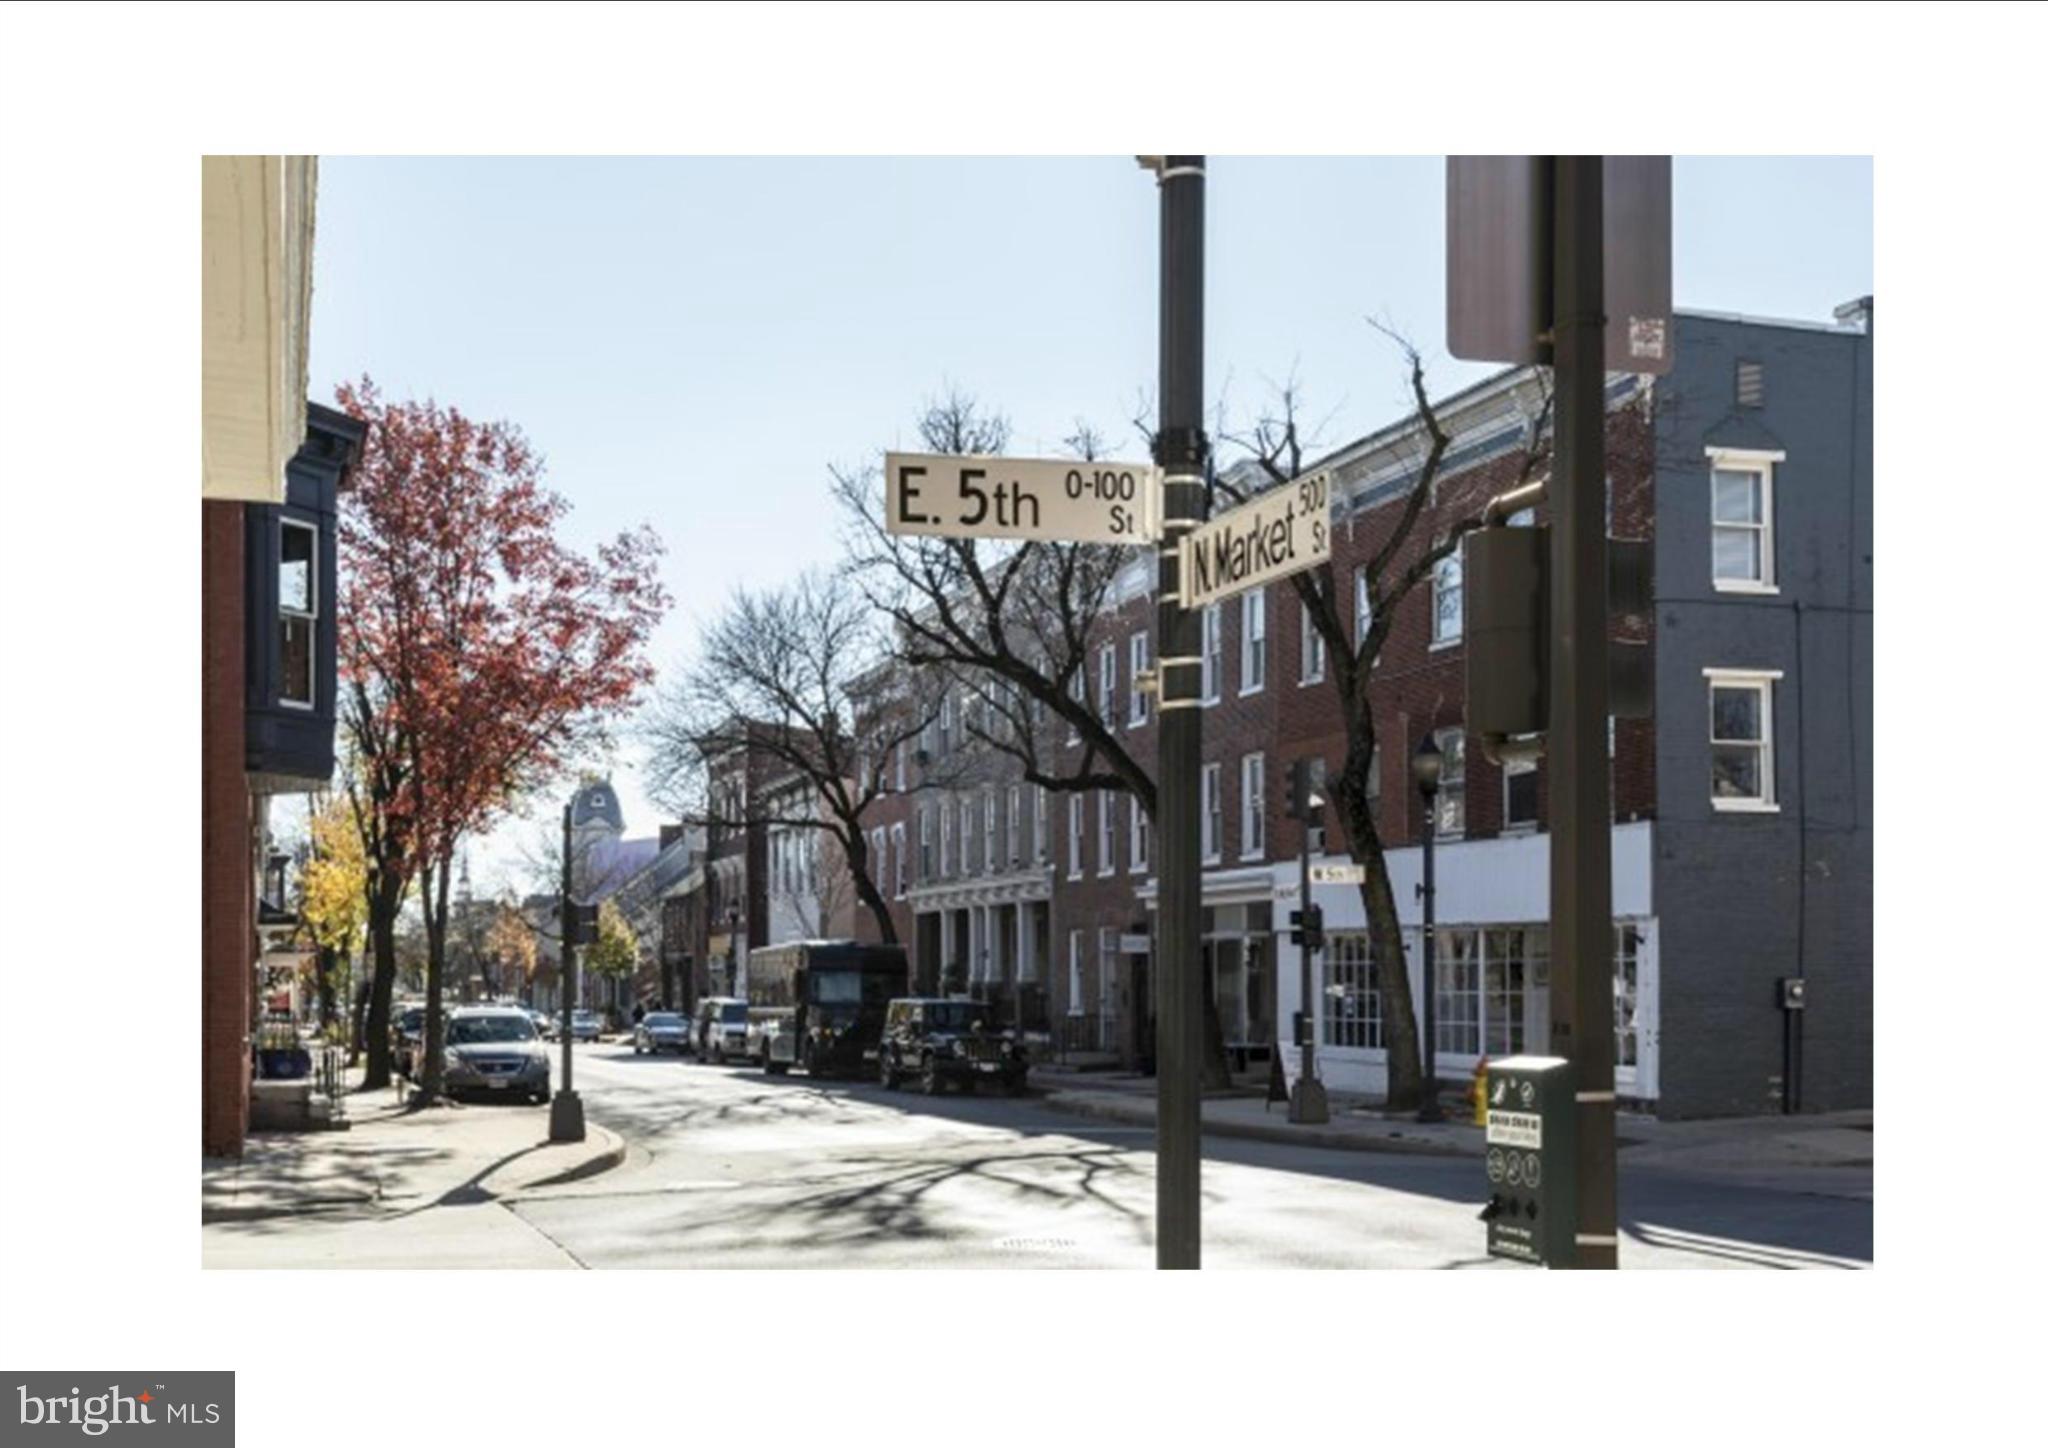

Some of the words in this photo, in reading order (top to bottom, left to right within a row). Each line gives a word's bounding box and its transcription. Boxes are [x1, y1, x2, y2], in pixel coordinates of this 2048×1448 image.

[898, 466, 942, 524] E.
[958, 469, 1040, 526] 5th
[1065, 470, 1136, 502] 0-100
[1298, 475, 1326, 517] 500
[1108, 504, 1135, 534] St
[1312, 520, 1326, 554] St
[1194, 536, 1212, 595] N.
[1215, 500, 1295, 588] Market
